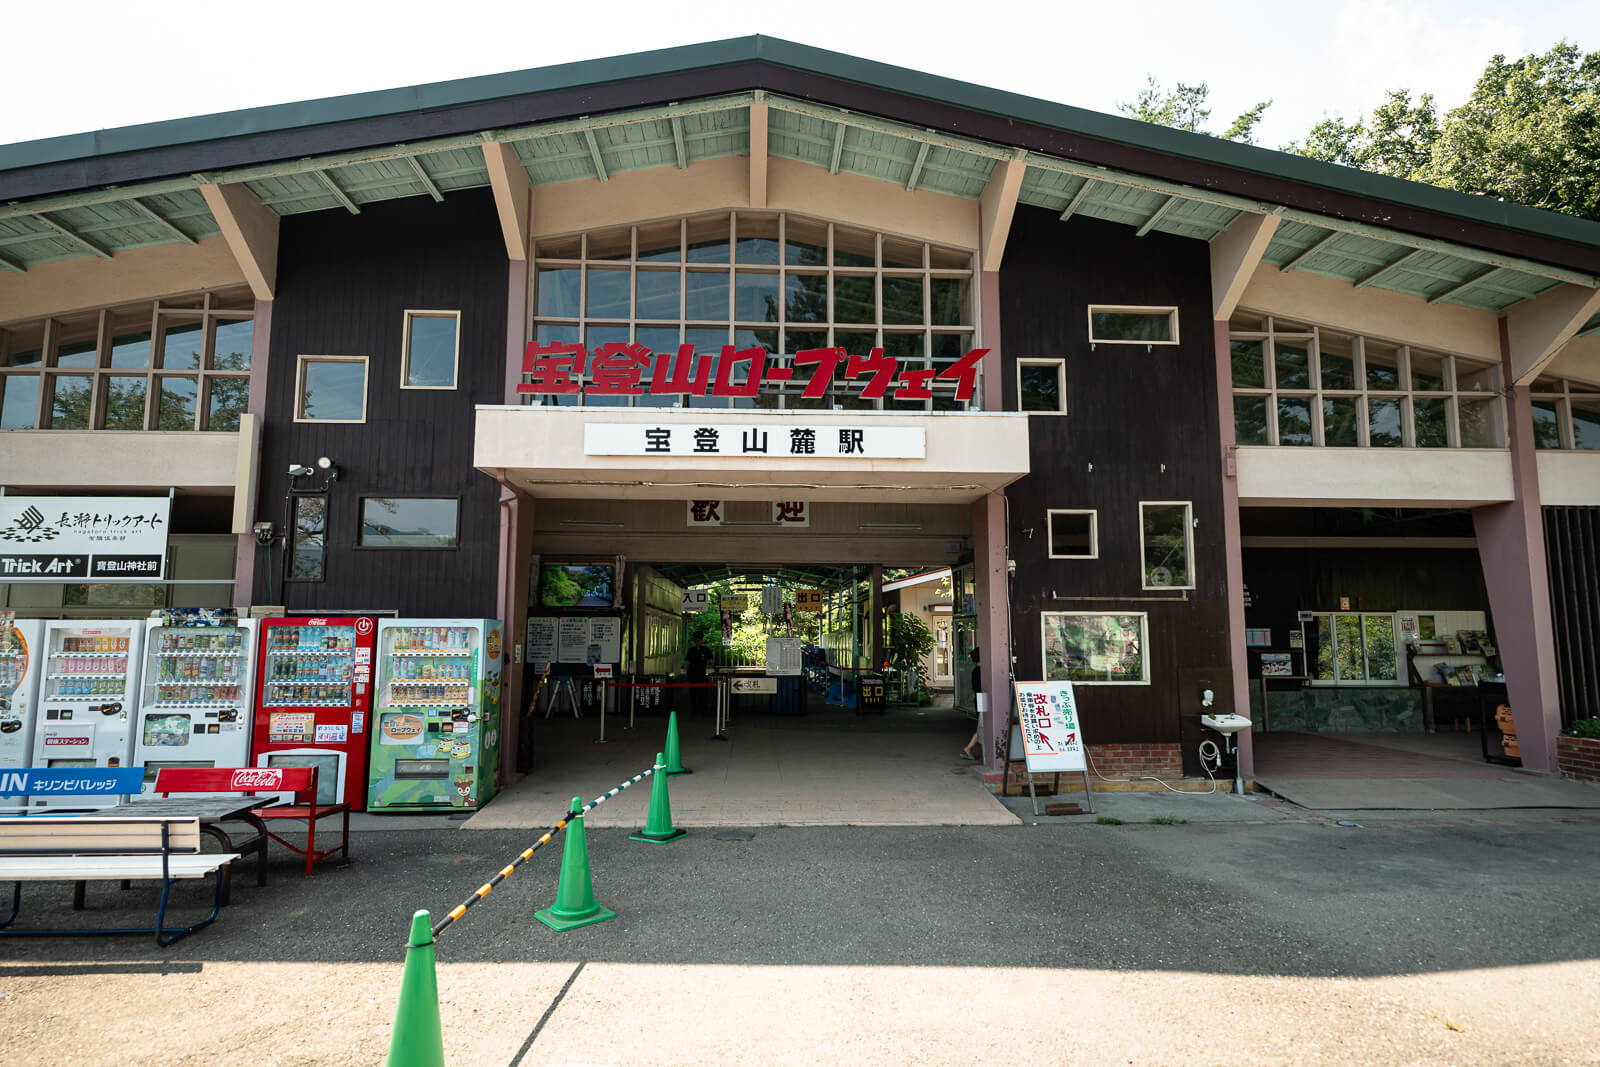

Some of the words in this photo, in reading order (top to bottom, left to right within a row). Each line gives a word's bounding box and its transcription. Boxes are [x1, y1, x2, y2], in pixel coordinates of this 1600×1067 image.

[516, 341, 991, 400] 宝登山ロープウェイ
[645, 427, 865, 454] 宝登山麓駅
[691, 500, 805, 522] 歓迎
[1, 558, 43, 573] Trick
[44, 557, 74, 573] Art
[683, 593, 706, 603] 入口
[798, 593, 820, 602] 出口
[744, 680, 760, 688] 改札
[862, 685, 884, 697] 出口
[1033, 693, 1052, 728] 改札口
[1060, 690, 1076, 730] きっぷ売り場
[33, 779, 117, 791] キリンビバレッジ
[233, 770, 278, 787] Coca-Cola
